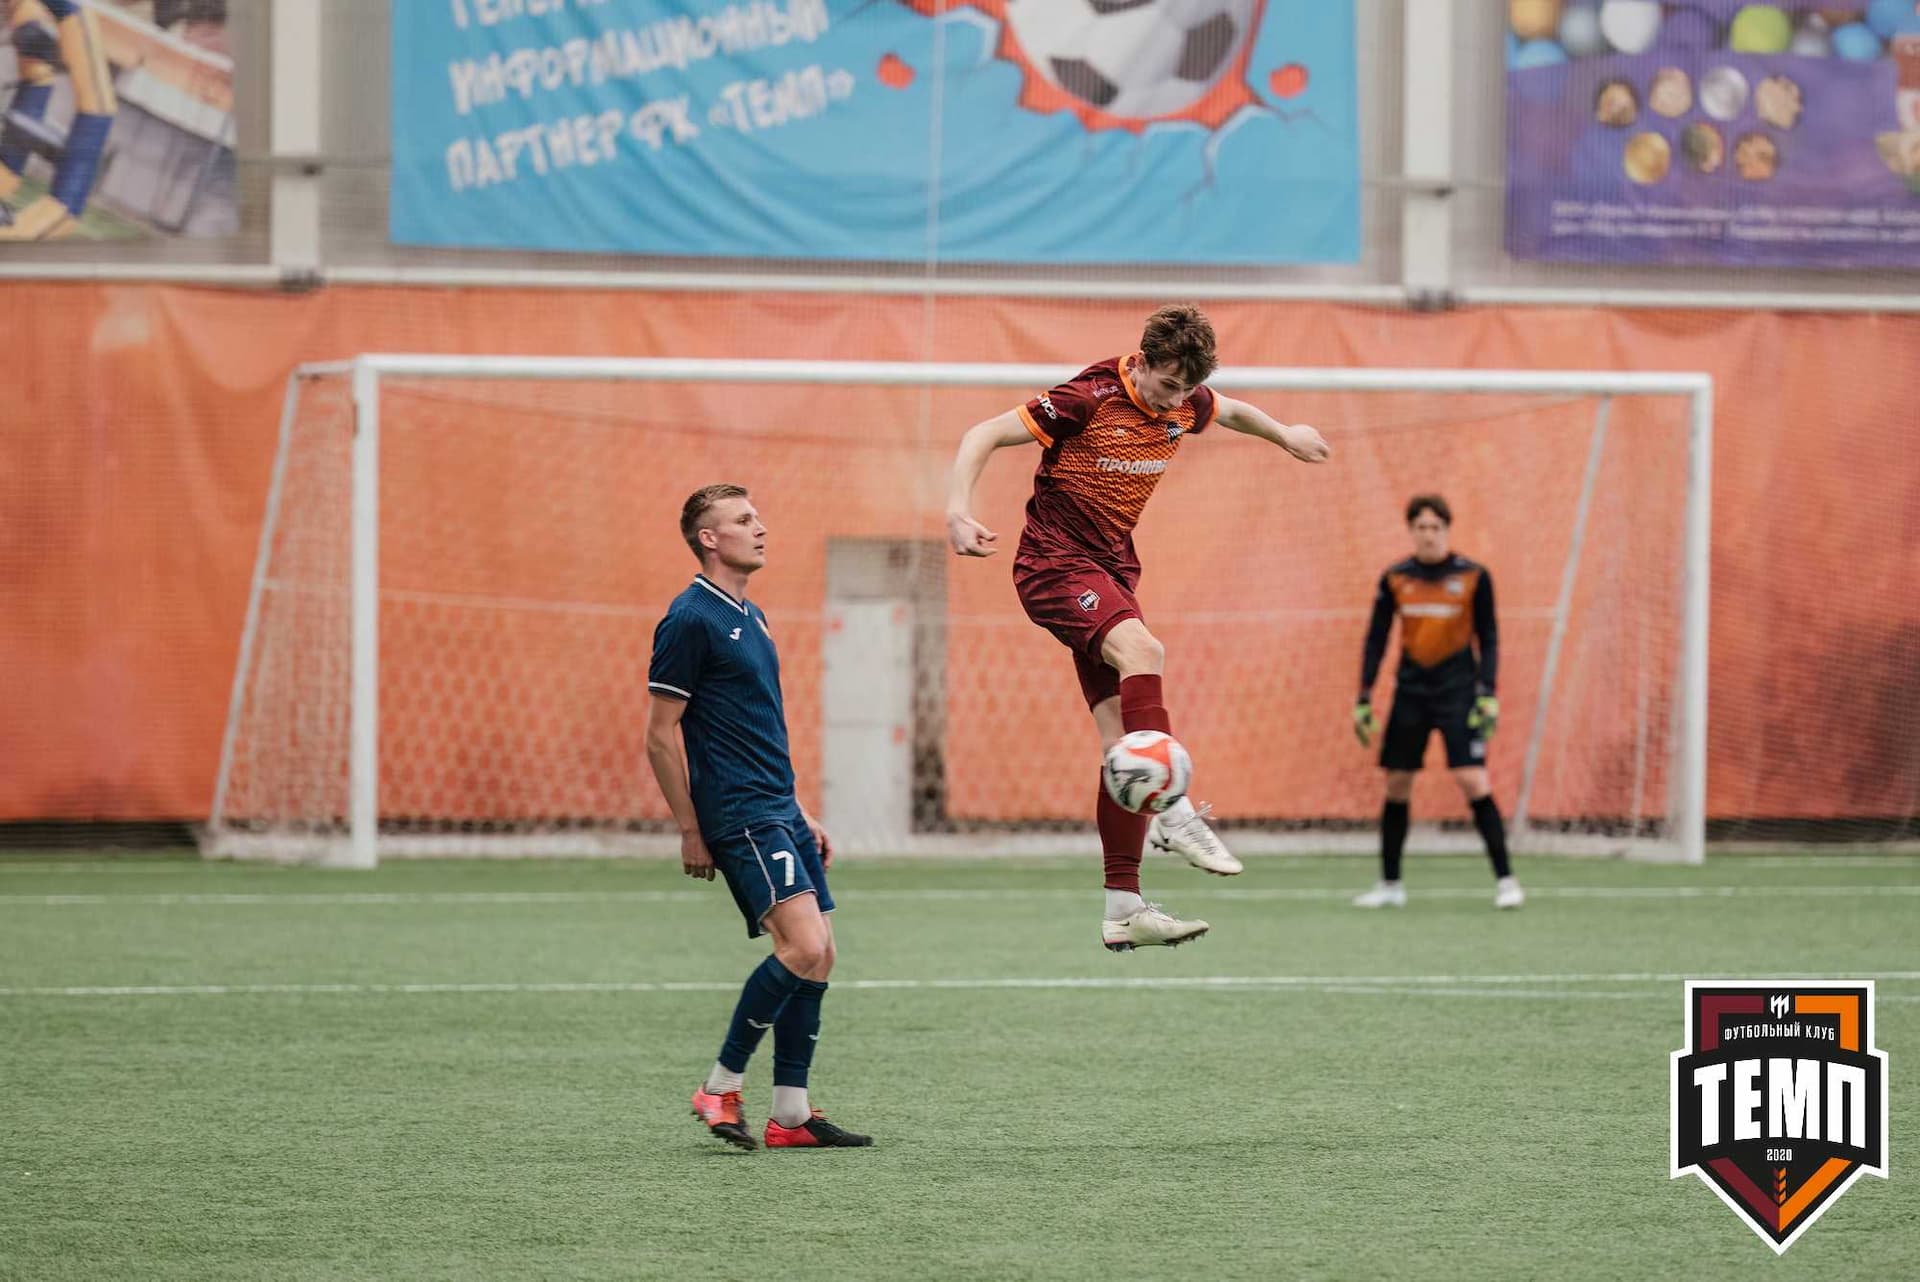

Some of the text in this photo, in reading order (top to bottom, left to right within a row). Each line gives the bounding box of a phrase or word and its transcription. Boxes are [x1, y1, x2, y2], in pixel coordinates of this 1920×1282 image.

[451, 0, 829, 113] ИНФОРМАЦИОННЫЙ
[447, 108, 623, 191] ПАРТНЕР
[630, 97, 698, 147] ФК
[771, 850, 795, 886] 7
